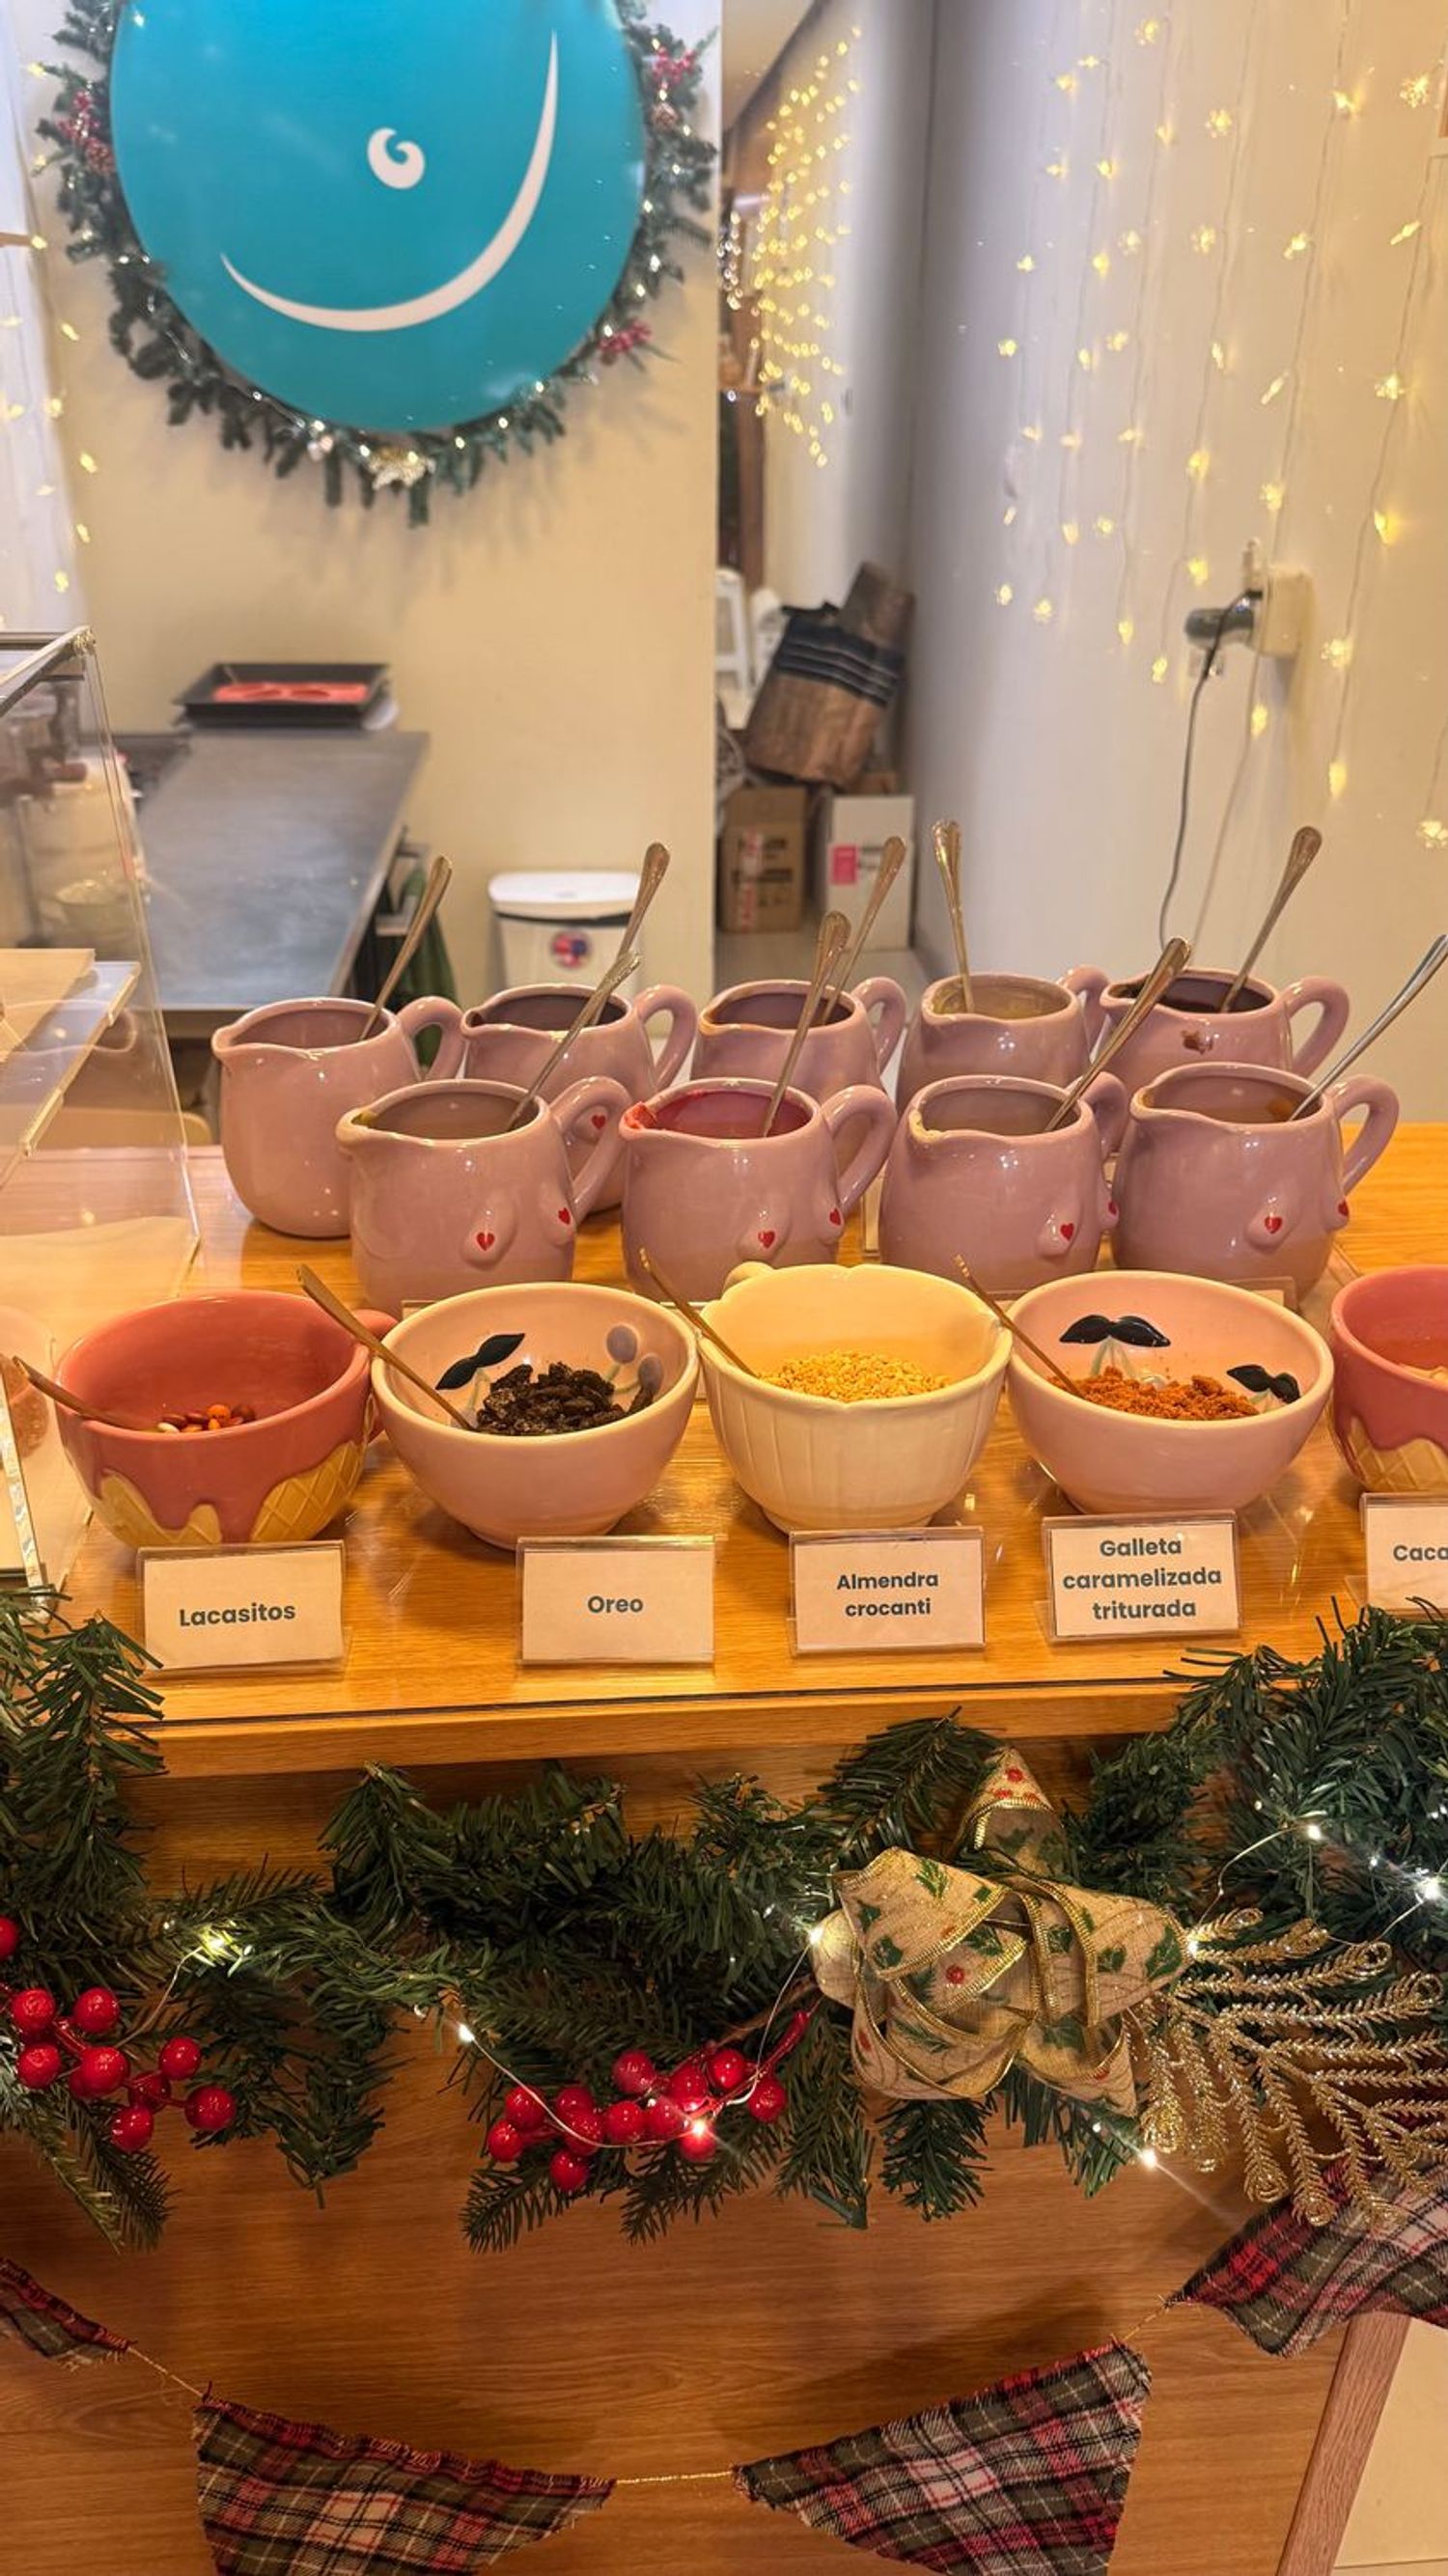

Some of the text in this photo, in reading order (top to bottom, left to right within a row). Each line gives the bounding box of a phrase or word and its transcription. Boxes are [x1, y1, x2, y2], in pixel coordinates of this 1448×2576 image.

[1099, 1537, 1183, 1557] Galleta
[836, 1569, 939, 1592] Almendra
[1063, 1565, 1223, 1591] caramelizada
[179, 1601, 296, 1628] Lacasitos
[587, 1594, 644, 1615] Oreo
[845, 1595, 932, 1618] crocanti
[1092, 1597, 1197, 1621] triturada
